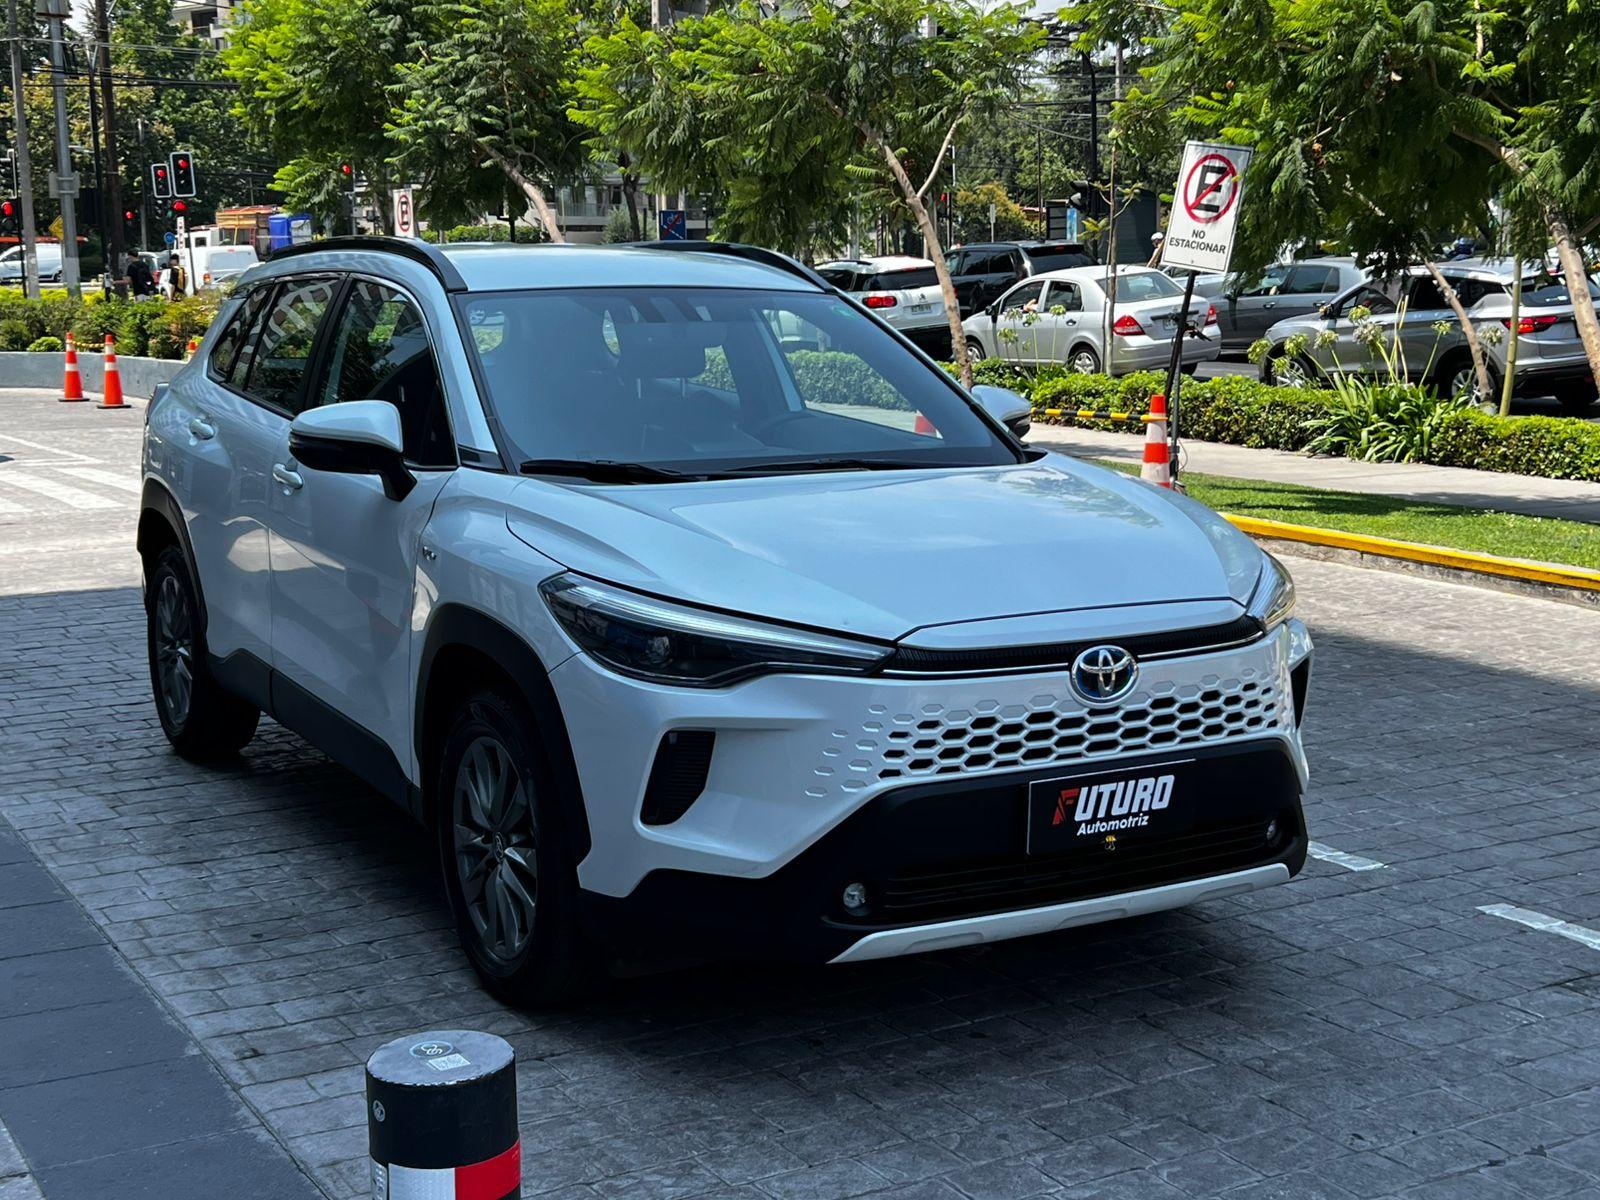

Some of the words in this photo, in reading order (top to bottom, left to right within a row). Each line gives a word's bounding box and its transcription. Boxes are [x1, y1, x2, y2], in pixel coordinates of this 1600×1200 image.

[1195, 164, 1228, 213] E
[1169, 236, 1226, 254] ESTACIONAR
[1191, 229, 1206, 239] NO
[1052, 774, 1175, 826] FUTURO
[1076, 813, 1150, 836] Automotriz
